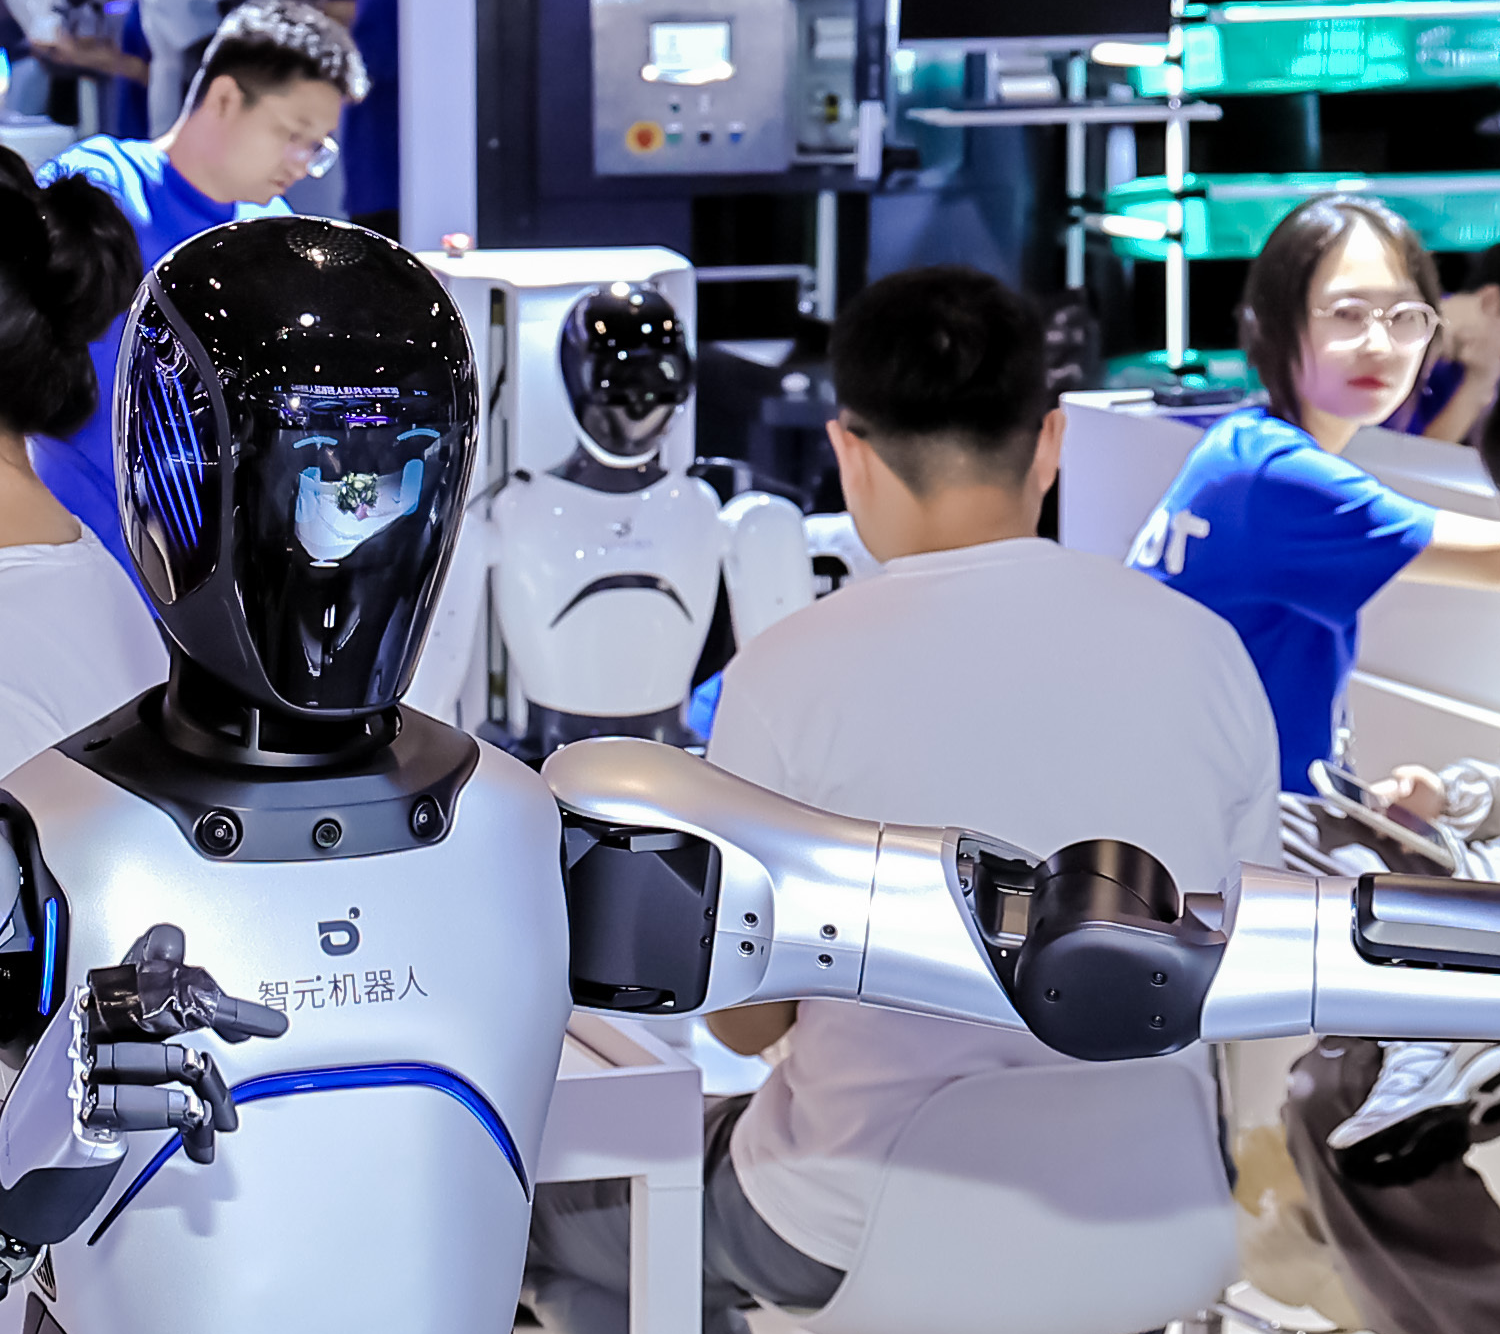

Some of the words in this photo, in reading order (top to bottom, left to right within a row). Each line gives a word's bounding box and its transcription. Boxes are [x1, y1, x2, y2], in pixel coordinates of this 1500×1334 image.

[257, 964, 428, 1012] 智元机器人
